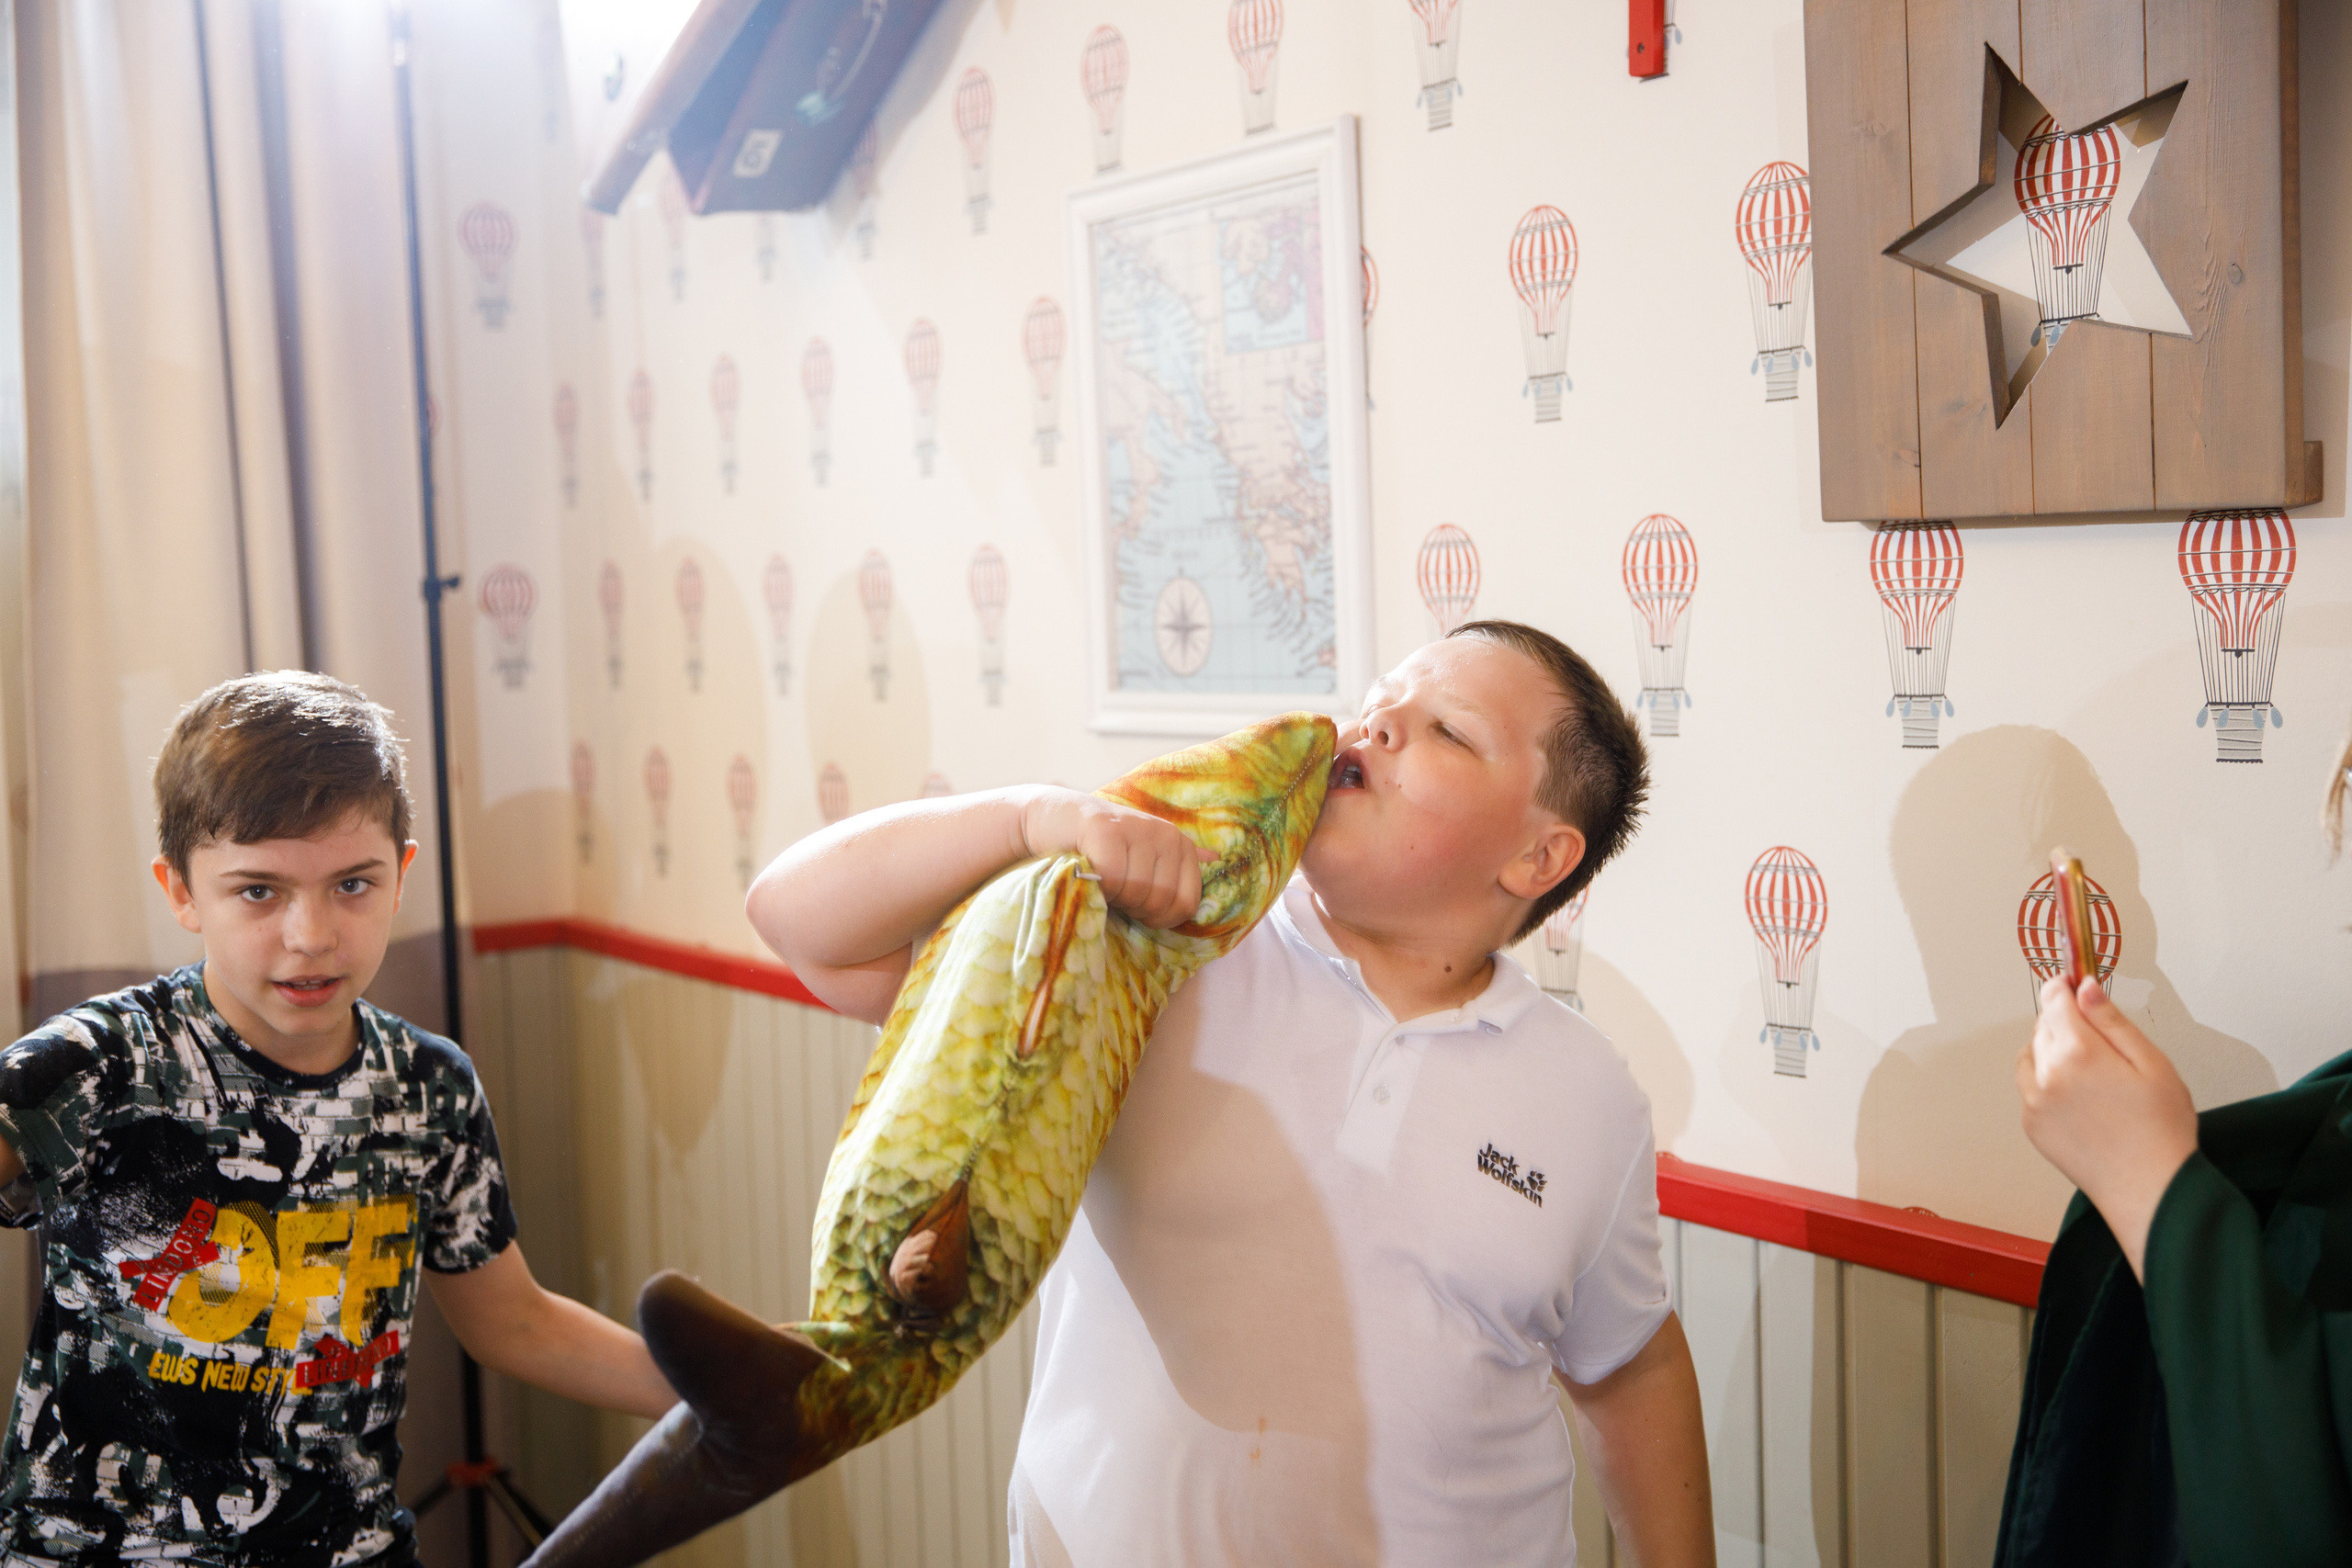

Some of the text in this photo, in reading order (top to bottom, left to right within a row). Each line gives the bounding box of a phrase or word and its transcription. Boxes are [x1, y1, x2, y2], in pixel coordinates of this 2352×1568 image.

[1476, 1154, 1543, 1209] Wolfskin
[1478, 1143, 1520, 1175] Jack
[167, 1199, 412, 1349] OFF
[147, 1350, 199, 1386] EWS
[200, 1359, 251, 1393] NEW
